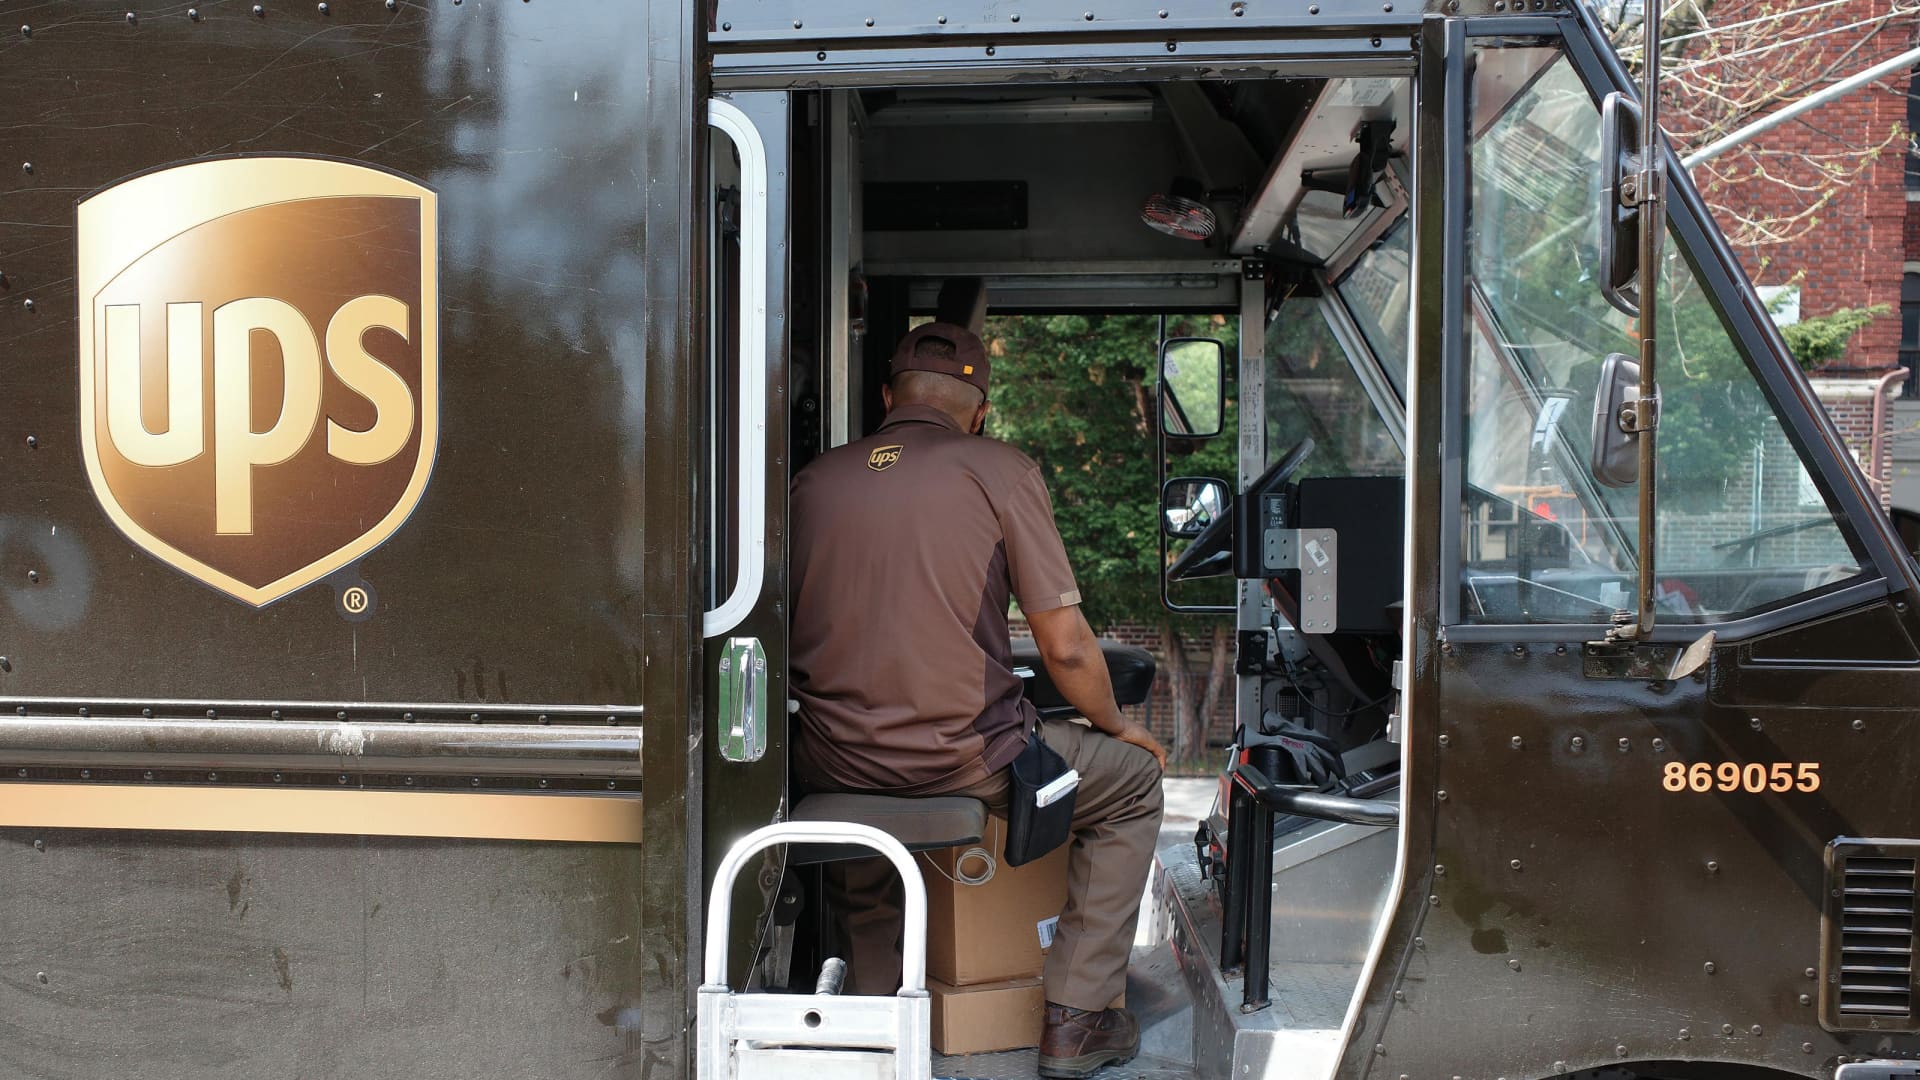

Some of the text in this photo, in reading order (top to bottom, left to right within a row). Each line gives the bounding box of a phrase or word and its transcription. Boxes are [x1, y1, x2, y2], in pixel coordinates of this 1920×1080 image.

[104, 295, 415, 535] ups
[871, 451, 899, 467] ups
[1662, 761, 1821, 794] 869055
